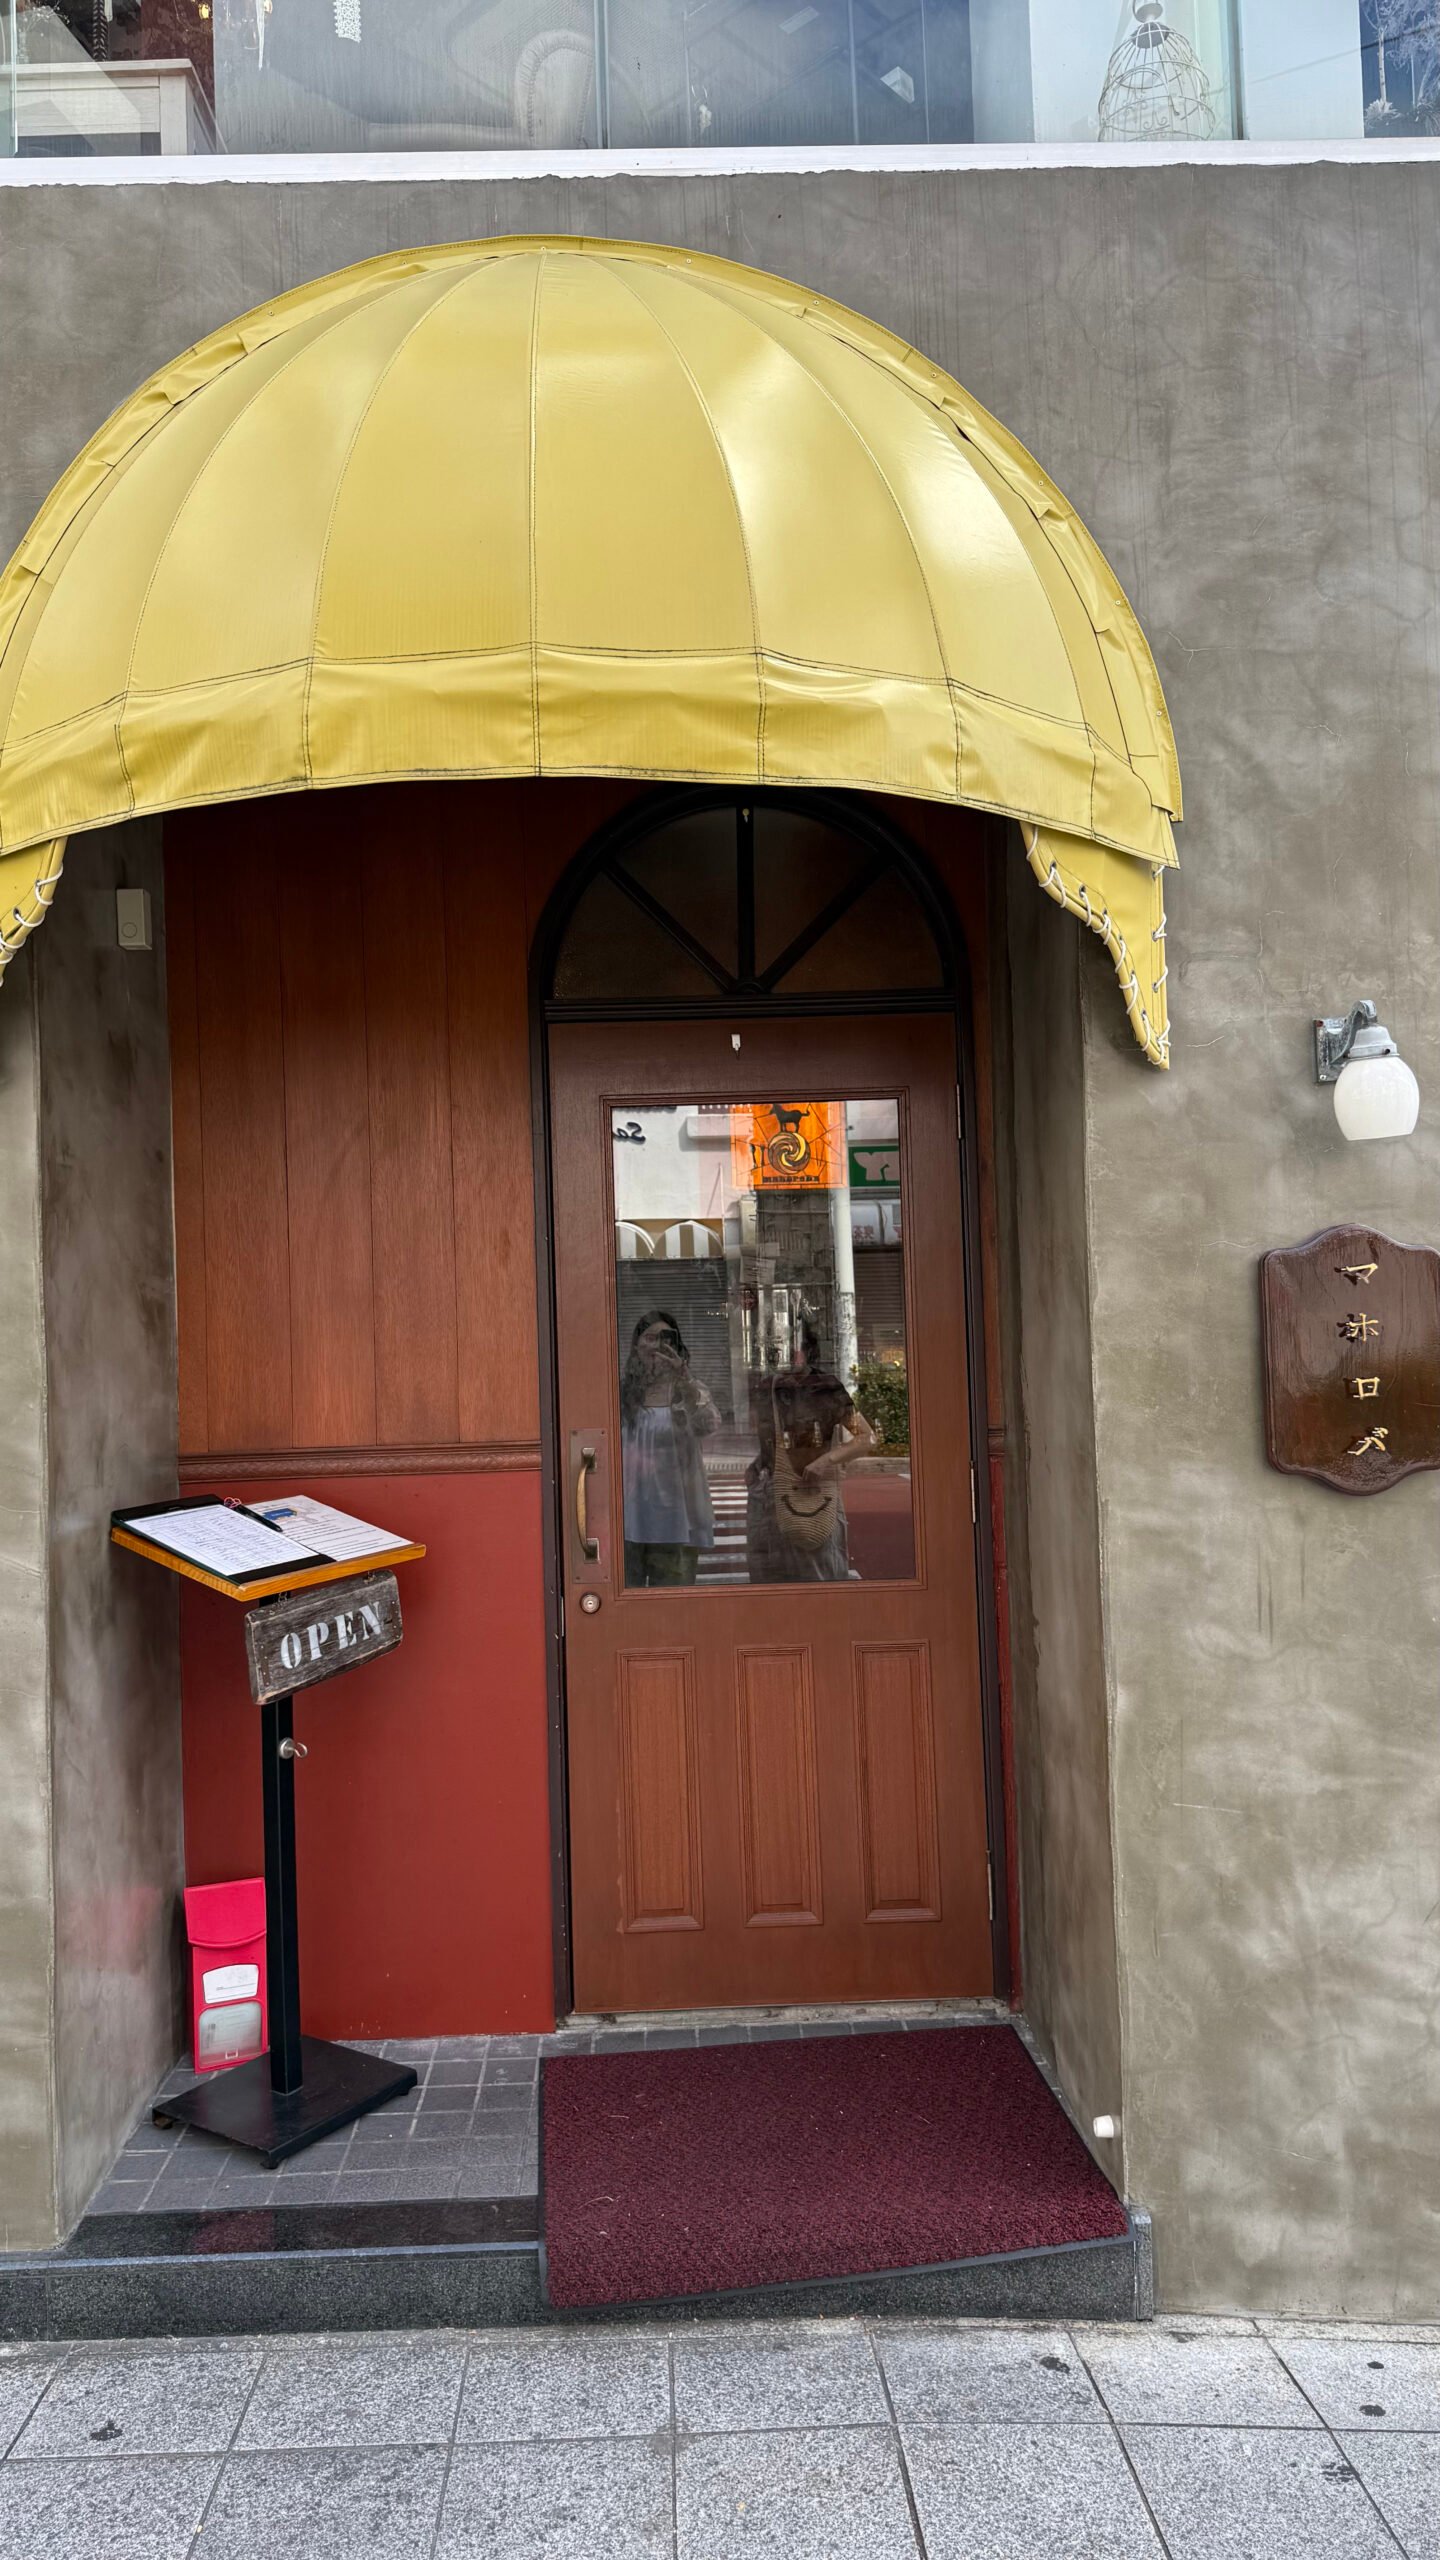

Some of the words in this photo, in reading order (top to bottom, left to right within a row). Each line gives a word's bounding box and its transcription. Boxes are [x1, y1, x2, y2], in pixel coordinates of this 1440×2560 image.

[1343, 1262, 1389, 1456] マホロバ
[280, 1601, 385, 1670] OPEN
